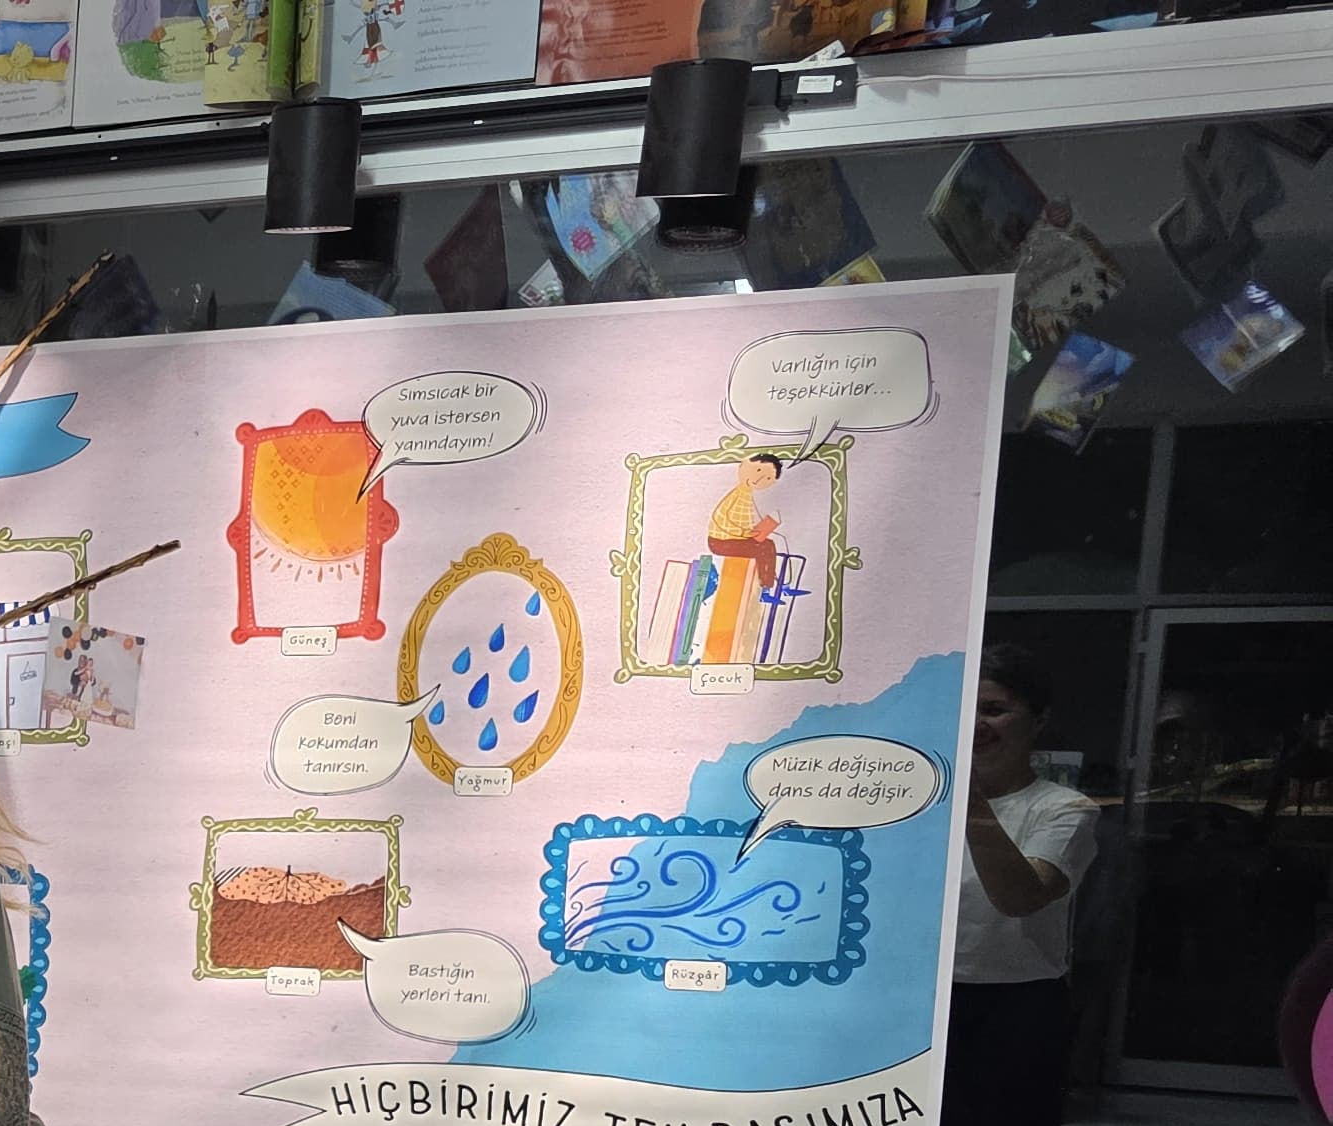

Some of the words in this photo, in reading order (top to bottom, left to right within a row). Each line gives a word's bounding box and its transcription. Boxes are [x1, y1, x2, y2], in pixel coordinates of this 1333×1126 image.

[770, 351, 840, 380] Varlığın
[843, 353, 879, 375] için
[397, 382, 471, 402] Sımsıcak
[475, 381, 499, 399] bir
[390, 410, 430, 432] yuva
[434, 408, 502, 426] istersen
[393, 432, 495, 456] yanındayım!
[289, 633, 329, 648] Güneş
[699, 669, 744, 690] Çocuk
[322, 711, 358, 727] Beni
[303, 758, 370, 775] tanırsın.
[771, 755, 823, 774] Müzik
[826, 753, 916, 779] değişince
[456, 773, 508, 793] Yağmur
[768, 781, 815, 799] dans
[818, 782, 842, 800] da
[846, 779, 914, 805] değişir.
[269, 973, 315, 989] Toprak
[407, 961, 476, 982] Bastığın
[670, 966, 721, 988] Rüzgâr
[399, 985, 453, 1005] yerleri
[453, 988, 492, 1005] tanı.
